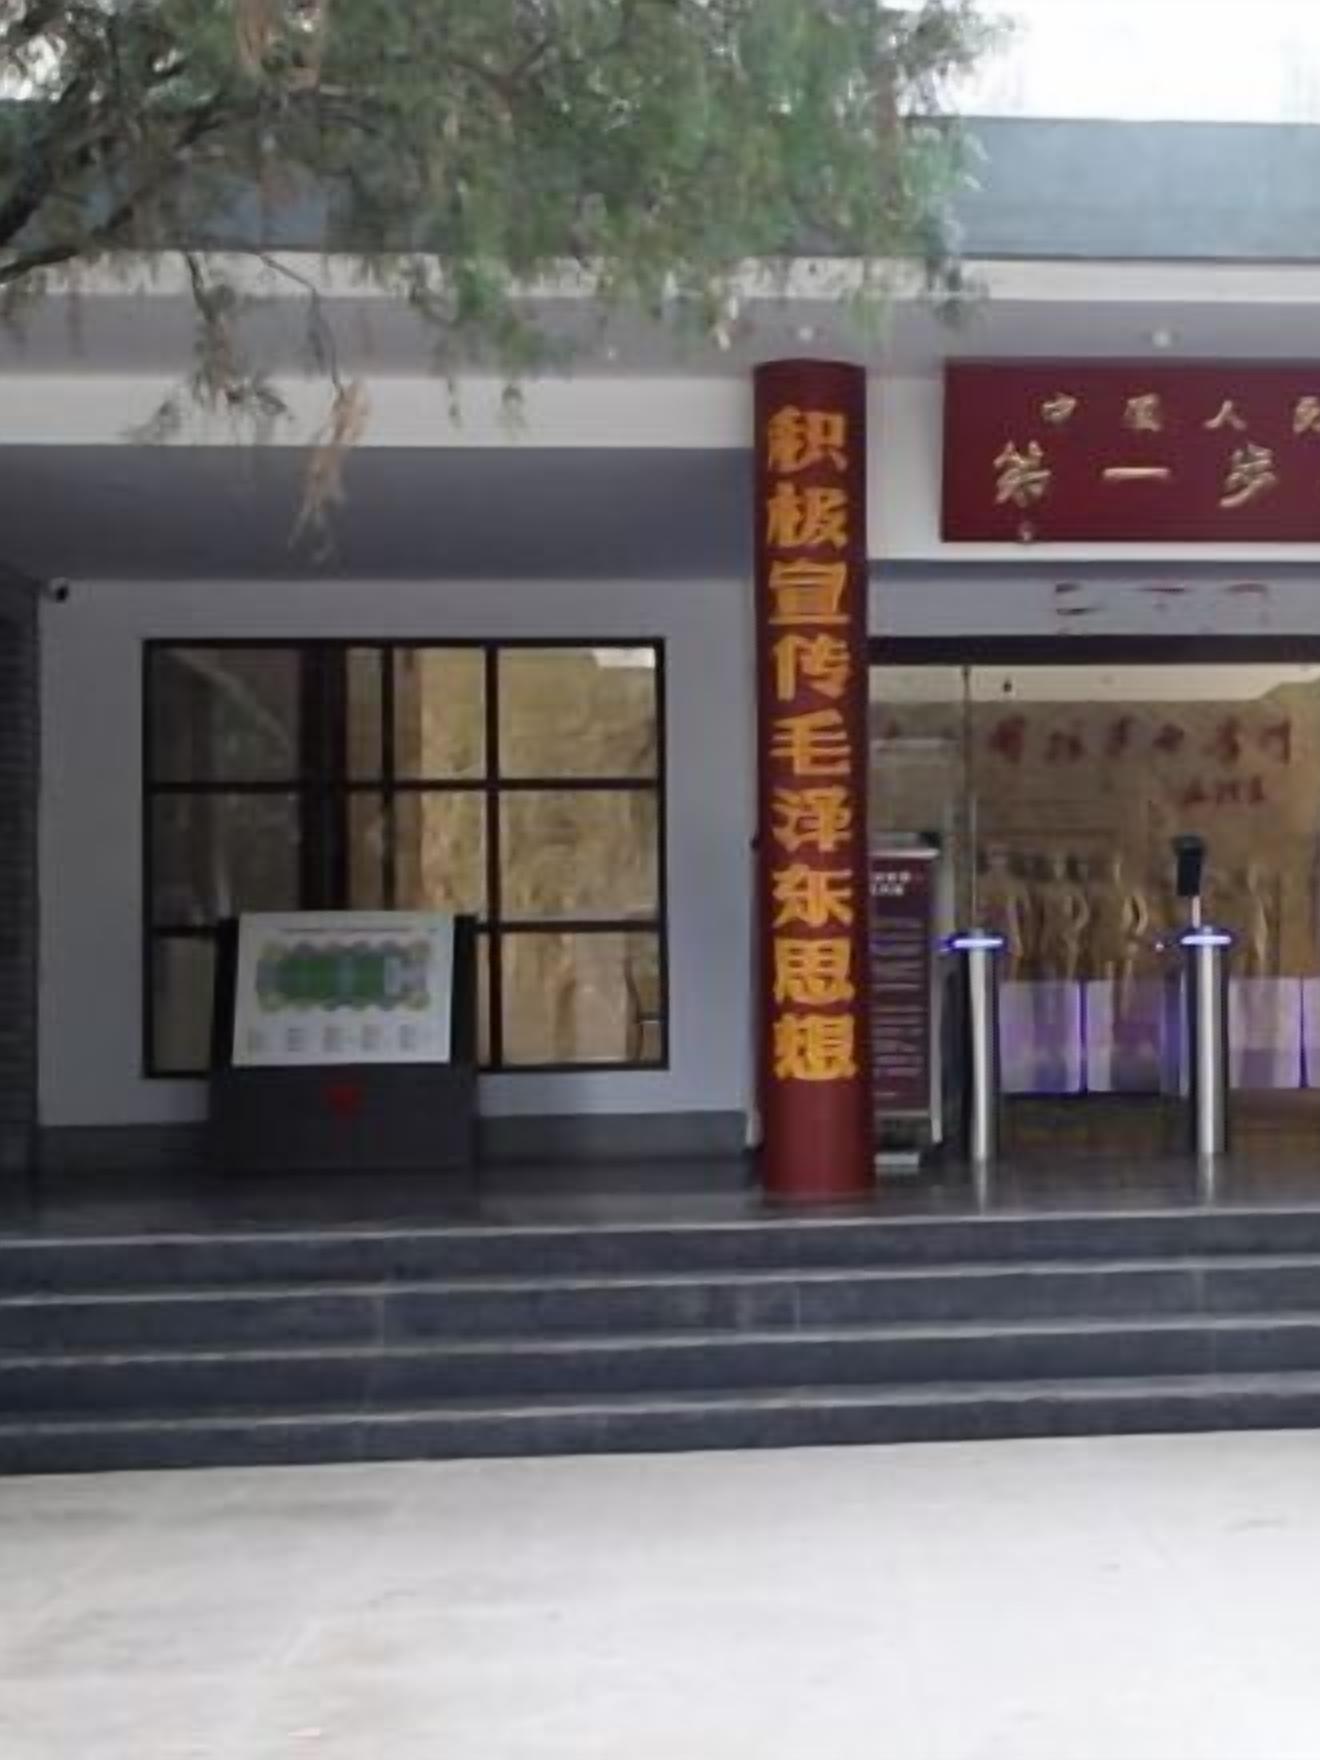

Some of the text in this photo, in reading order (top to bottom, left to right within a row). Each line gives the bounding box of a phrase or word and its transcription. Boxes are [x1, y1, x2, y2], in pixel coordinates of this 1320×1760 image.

[767, 406, 858, 1081] 积极宣传毛泽东思想
